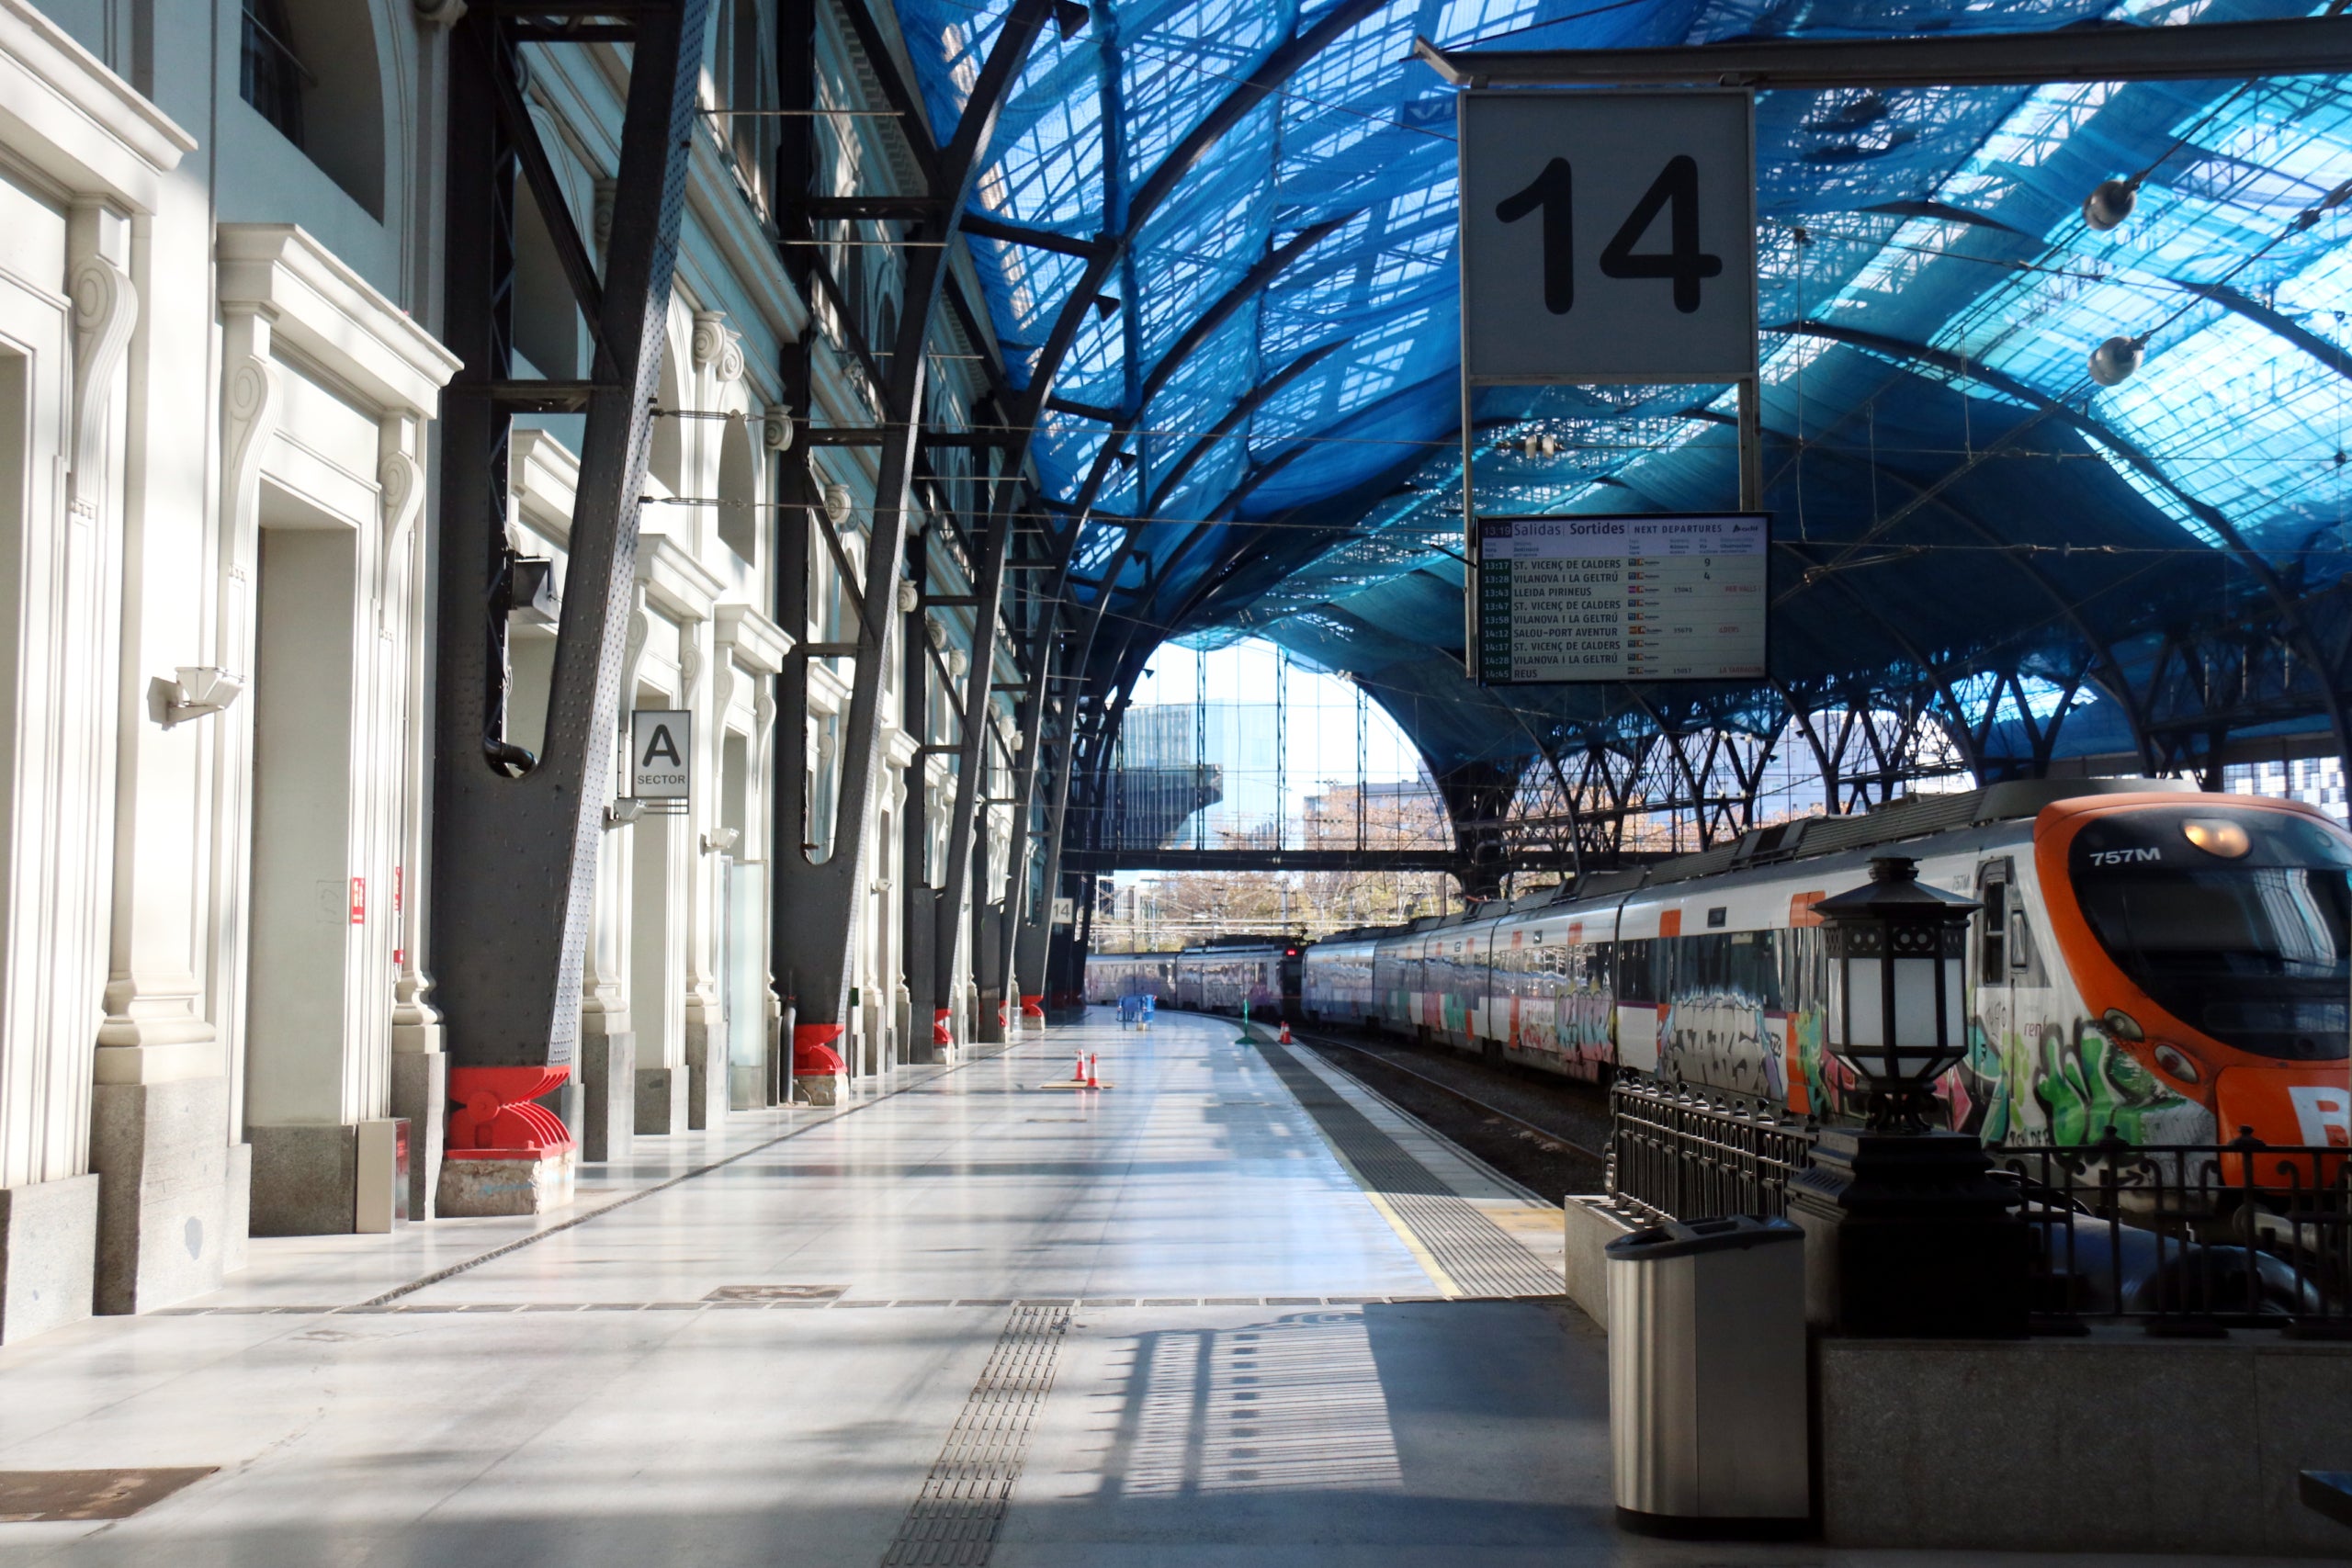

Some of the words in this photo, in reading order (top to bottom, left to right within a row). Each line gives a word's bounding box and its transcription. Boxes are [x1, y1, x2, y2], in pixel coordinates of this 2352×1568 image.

[1496, 153, 1724, 315] 14
[1514, 524, 1561, 536] Salidas
[1570, 523, 1625, 536] Sortides
[1634, 525, 1657, 534] NEXT
[1662, 525, 1723, 534] DEPARTURES
[1484, 561, 1510, 570] 13:17
[1514, 561, 1528, 570] ST.
[1531, 560, 1563, 571] VICENÇ
[1566, 560, 1578, 569] DE
[1581, 559, 1622, 569] CALDERS
[1704, 558, 1711, 567] 9
[1484, 575, 1510, 583] 13:28
[1514, 574, 1559, 583] VILANOVA
[1569, 574, 1580, 582] LA
[1583, 571, 1619, 582] GELTRÚ
[1704, 571, 1711, 581] 4
[1484, 589, 1510, 598] 13:43
[1514, 588, 1545, 597] LLEIDA
[1549, 587, 1592, 596] PIRINEUS
[1484, 603, 1510, 612] 13:47
[1514, 602, 1528, 612] ST.
[1531, 601, 1563, 613] VICENÇ
[1566, 601, 1578, 610] DE
[1581, 600, 1621, 610] CALDERS
[1484, 616, 1510, 625] 13:58
[1514, 615, 1559, 625] VILANOVA
[1569, 615, 1580, 624] LA
[1583, 612, 1618, 624] GELTRÚ
[1484, 630, 1510, 638] 14:12
[1514, 627, 1572, 638] SALOU-PORT
[1576, 627, 1618, 637] AVENTUR
[1484, 644, 1510, 652] 14:17
[1514, 642, 1528, 652] ST.
[1531, 642, 1563, 653] VICENÇ
[1566, 642, 1578, 650] DE
[1581, 640, 1621, 650] CALDERS
[1484, 657, 1510, 666] 14:28
[1514, 656, 1559, 665] VILANOVA
[1569, 655, 1579, 664] LA
[1583, 653, 1618, 664] GELTRÚ
[1484, 671, 1510, 679] 14:45
[1514, 670, 1537, 679] REUS
[642, 724, 682, 767] A
[638, 774, 685, 784] SECTOR
[2089, 846, 2162, 867] 757M
[1053, 903, 1070, 918] 14
[2023, 1014, 2048, 1037] renf
